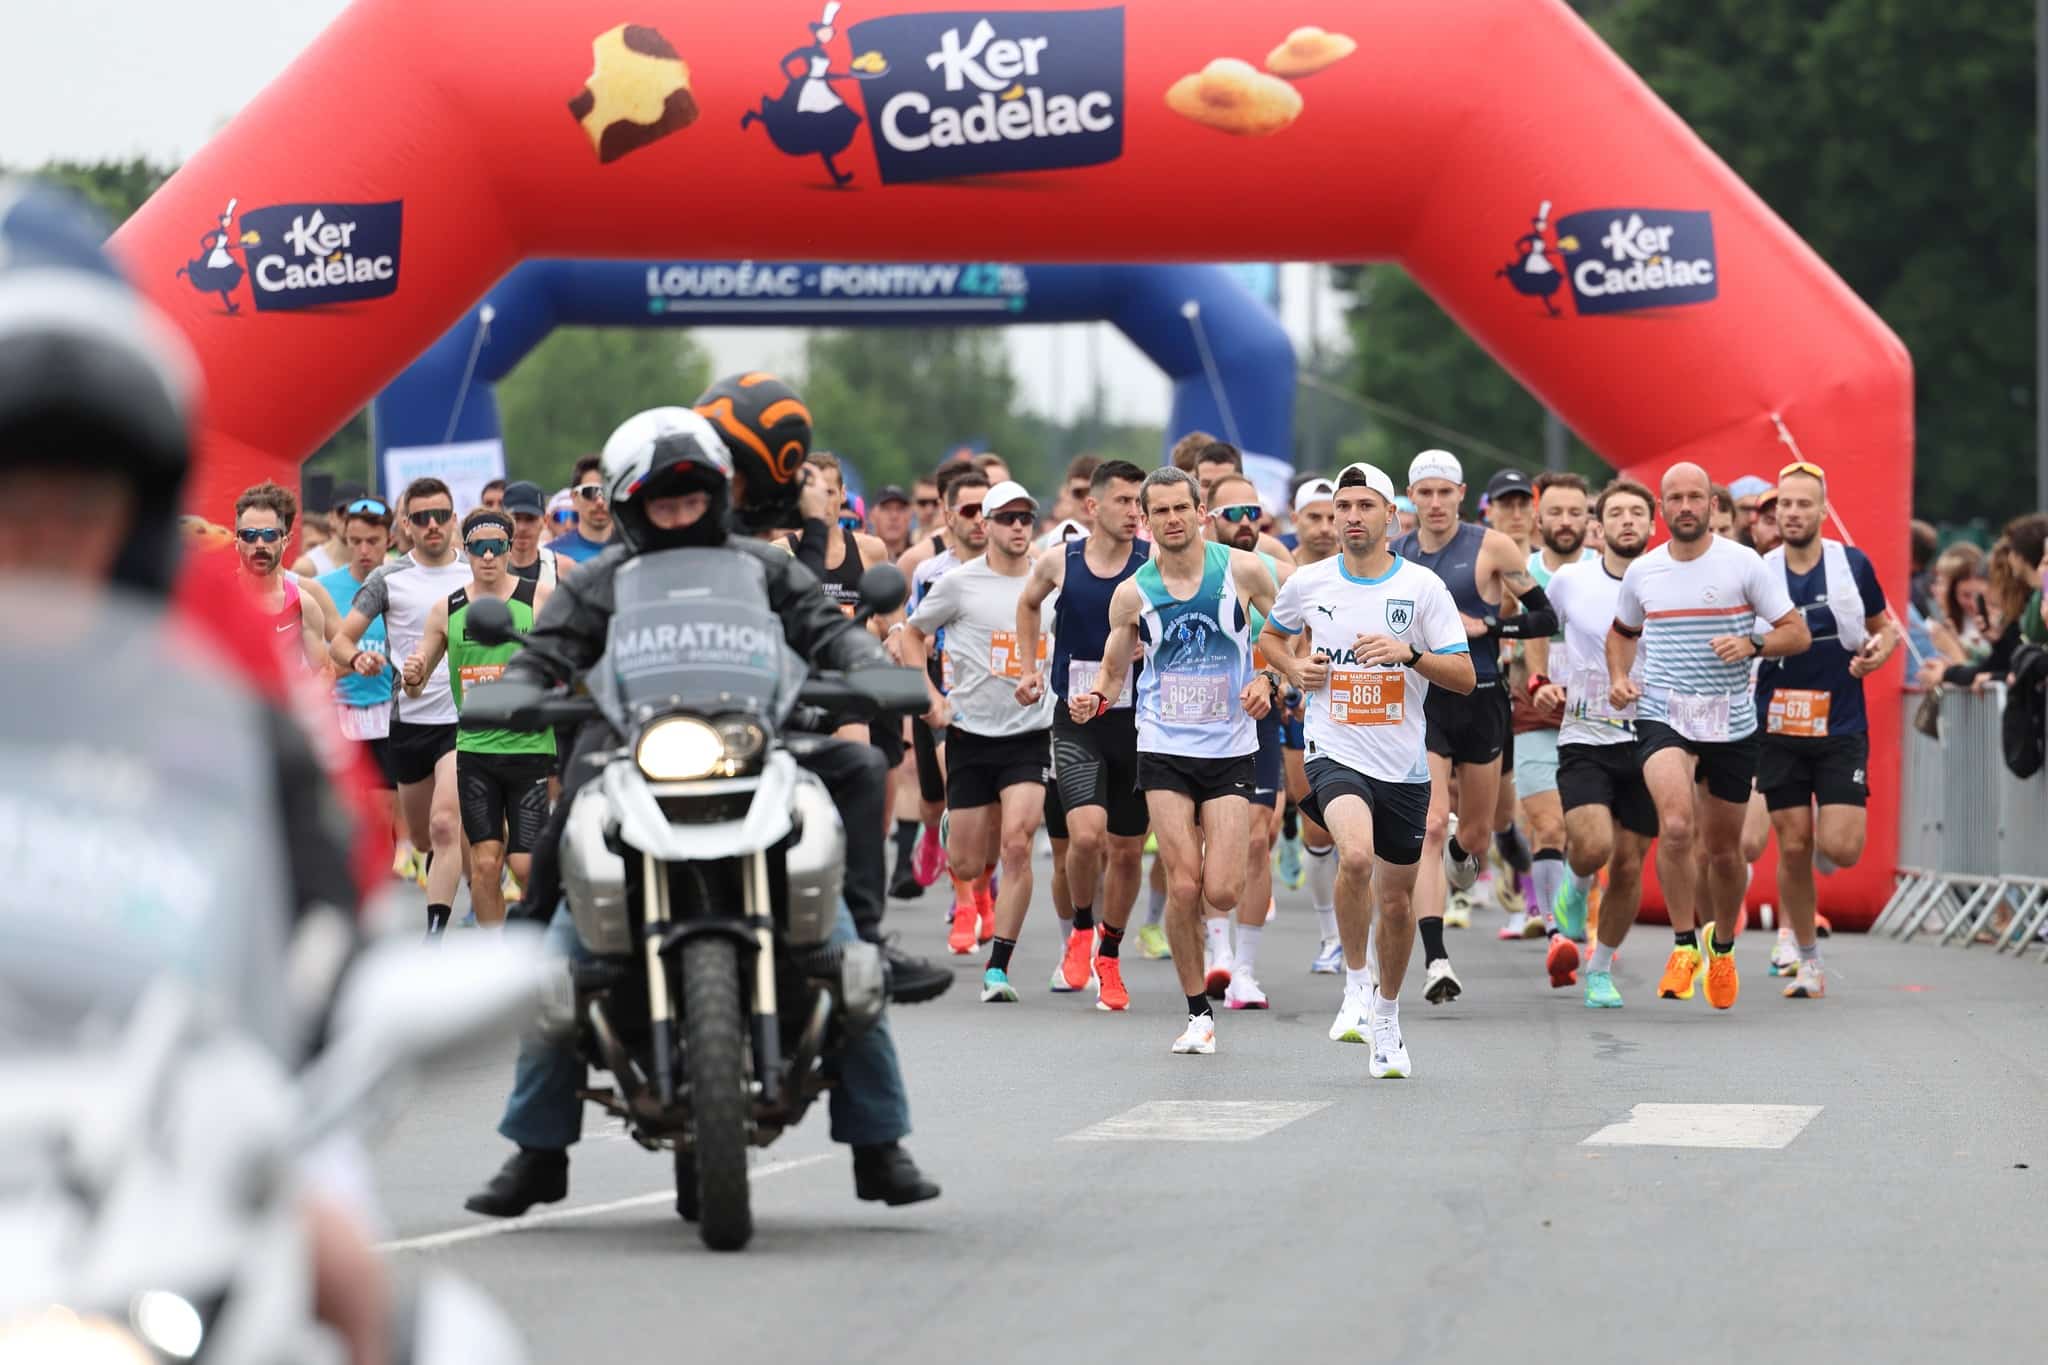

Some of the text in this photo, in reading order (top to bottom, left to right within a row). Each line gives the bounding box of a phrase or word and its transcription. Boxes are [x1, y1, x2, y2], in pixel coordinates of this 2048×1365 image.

[926, 18, 1048, 91] Ker
[880, 84, 1114, 152] Cadélac
[283, 208, 356, 256] Ker
[1601, 213, 1674, 261] Ker
[255, 251, 394, 292] Cadélac
[647, 259, 800, 297] LOUDÉAC
[820, 264, 960, 297] PONTIVY
[959, 261, 1000, 294] 42
[1574, 255, 1714, 297] Cadélac
[615, 622, 777, 657] MARATHON
[1169, 685, 1219, 705] 8026-1
[1352, 684, 1382, 705] 868
[1786, 701, 1811, 719] 678
